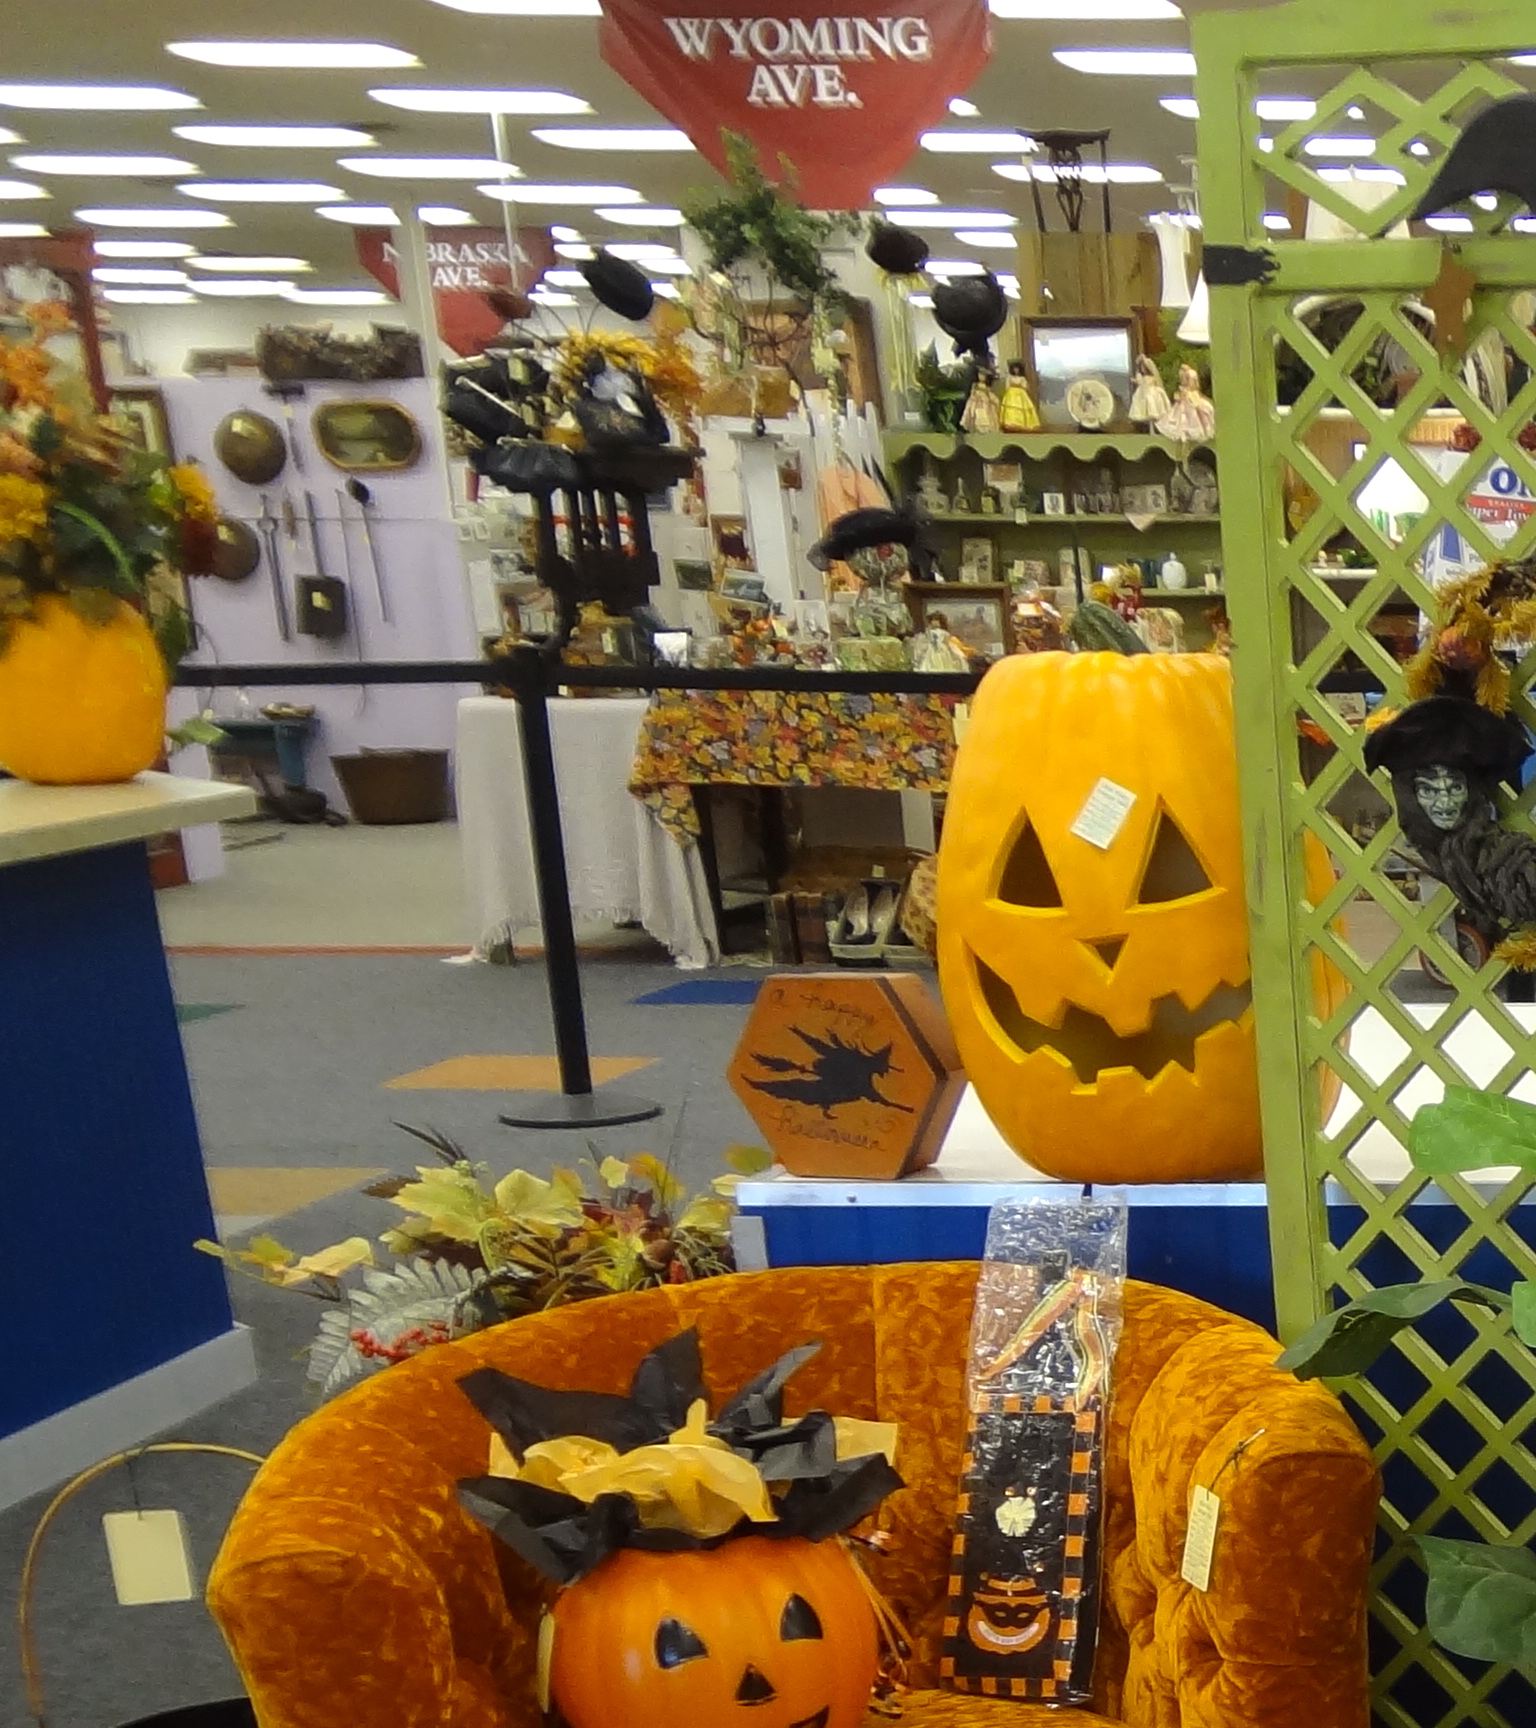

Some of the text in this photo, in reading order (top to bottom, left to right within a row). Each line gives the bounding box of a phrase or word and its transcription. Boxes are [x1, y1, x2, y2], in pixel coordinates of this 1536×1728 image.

[663, 17, 932, 60] WYOMING
[747, 64, 863, 108] AVE.
[382, 241, 530, 267] NBRASKA
[433, 267, 489, 287] AVE.
